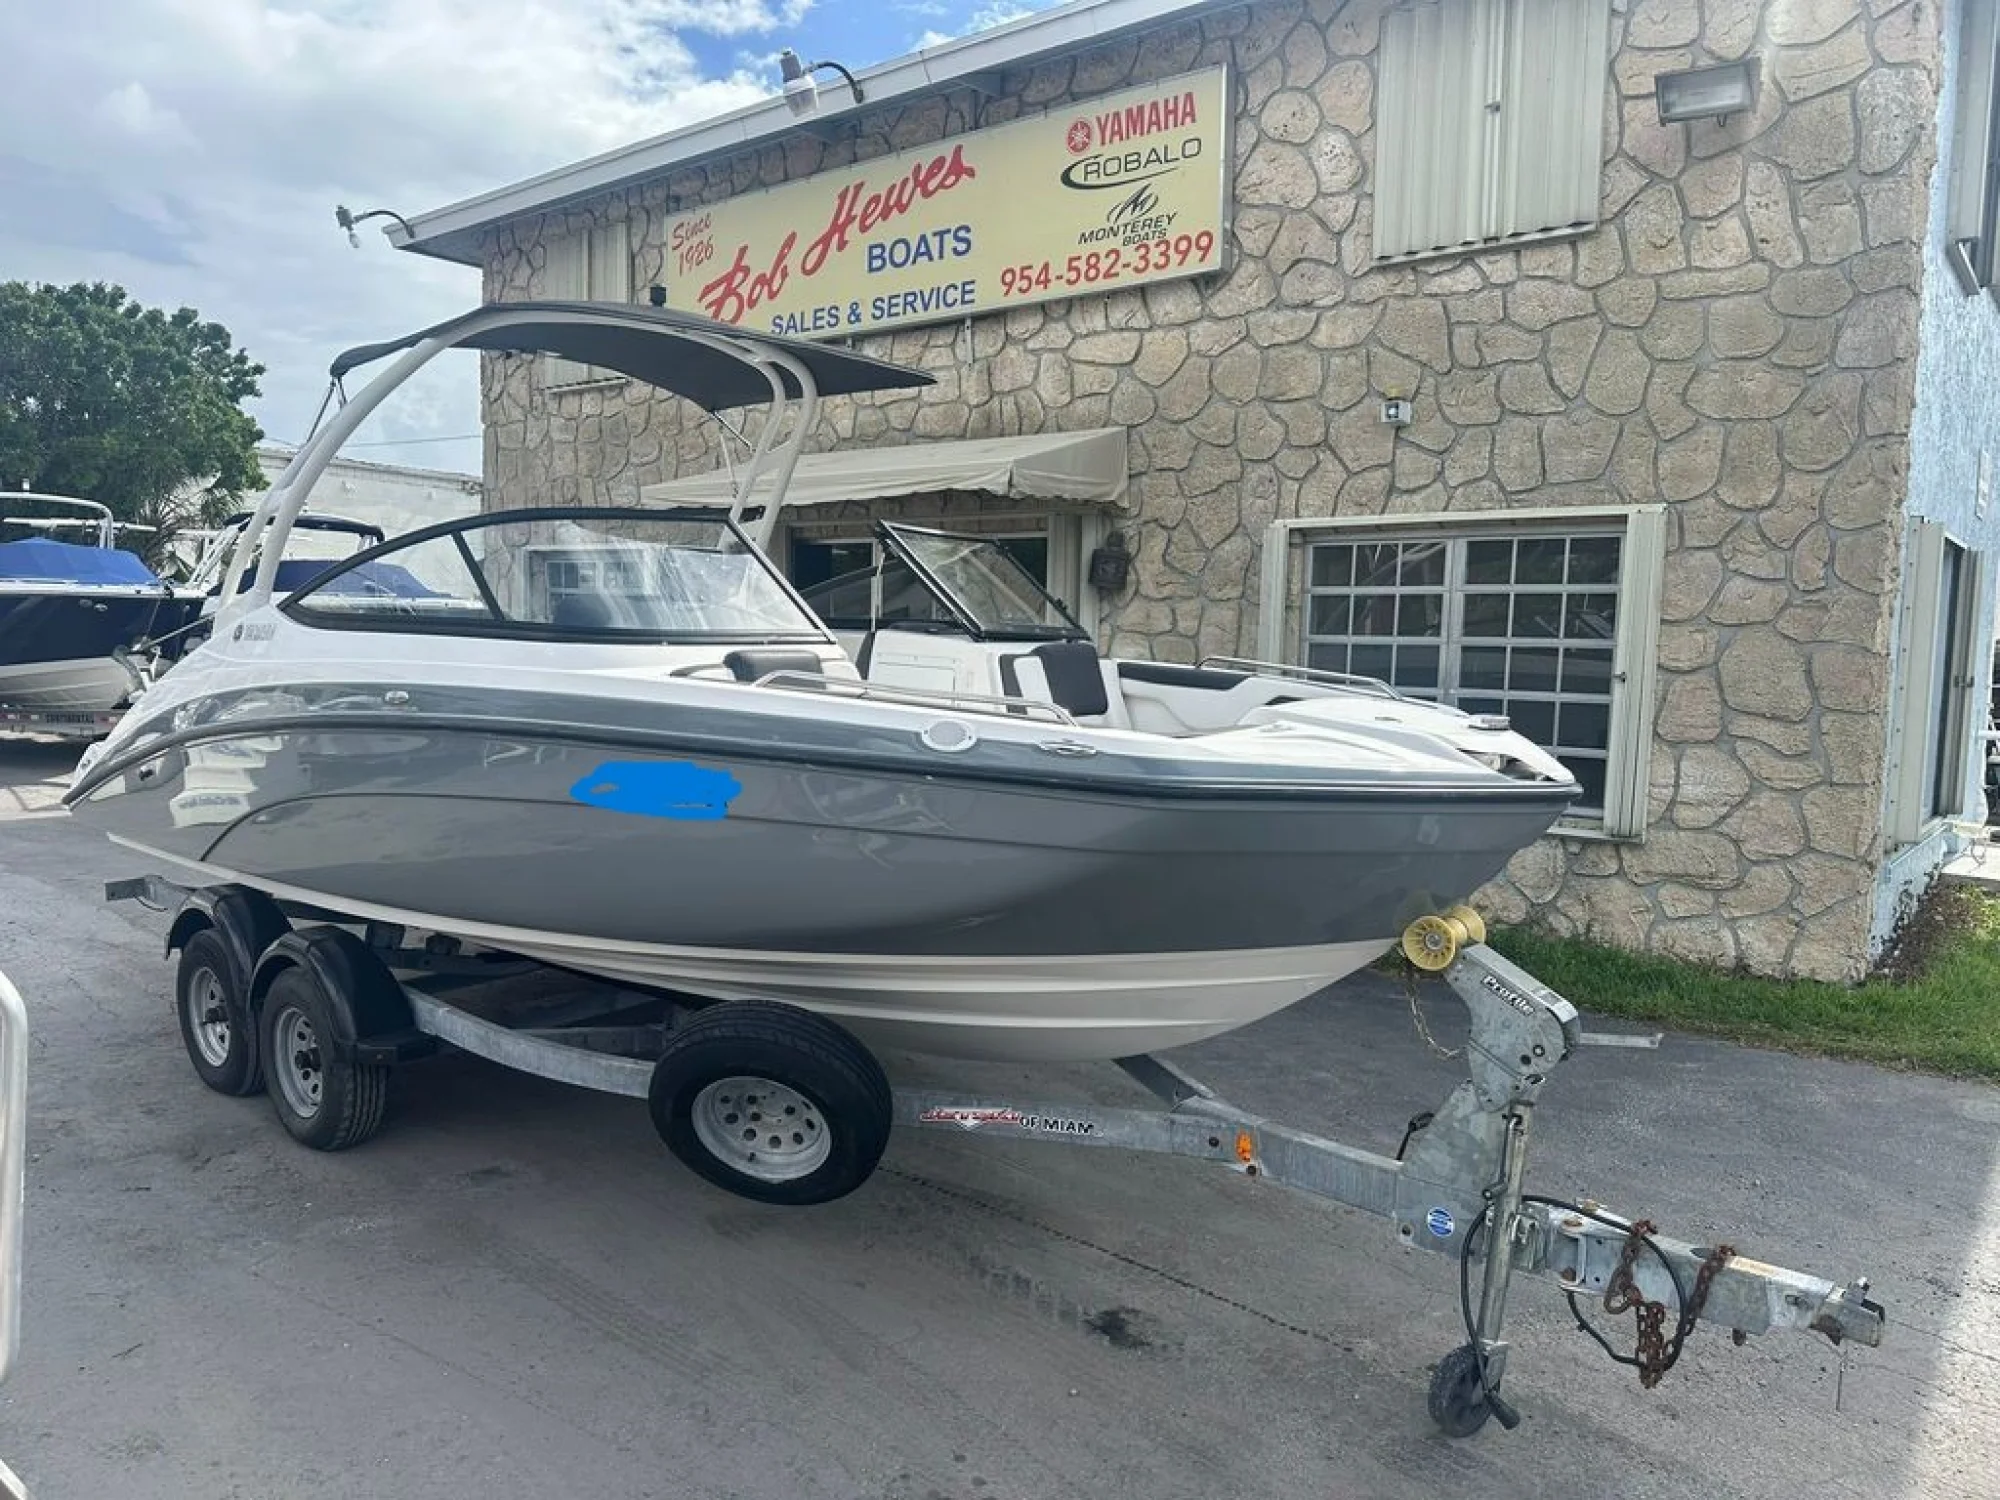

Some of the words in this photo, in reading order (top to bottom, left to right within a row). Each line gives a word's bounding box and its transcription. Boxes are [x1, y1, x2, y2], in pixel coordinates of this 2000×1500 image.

[1095, 91, 1197, 147] YAMAHA
[1083, 137, 1202, 182] ROBALO
[671, 212, 712, 251] Since
[698, 230, 798, 325] Bob
[800, 143, 976, 277] Hewes
[866, 224, 972, 274] BOATS
[1077, 211, 1178, 245] MONTEREY
[1122, 228, 1168, 247] BOATS
[1000, 230, 1214, 298] 954-582-3399
[771, 304, 841, 335] SALES
[847, 302, 863, 325] &
[870, 279, 977, 321] SERVICE
